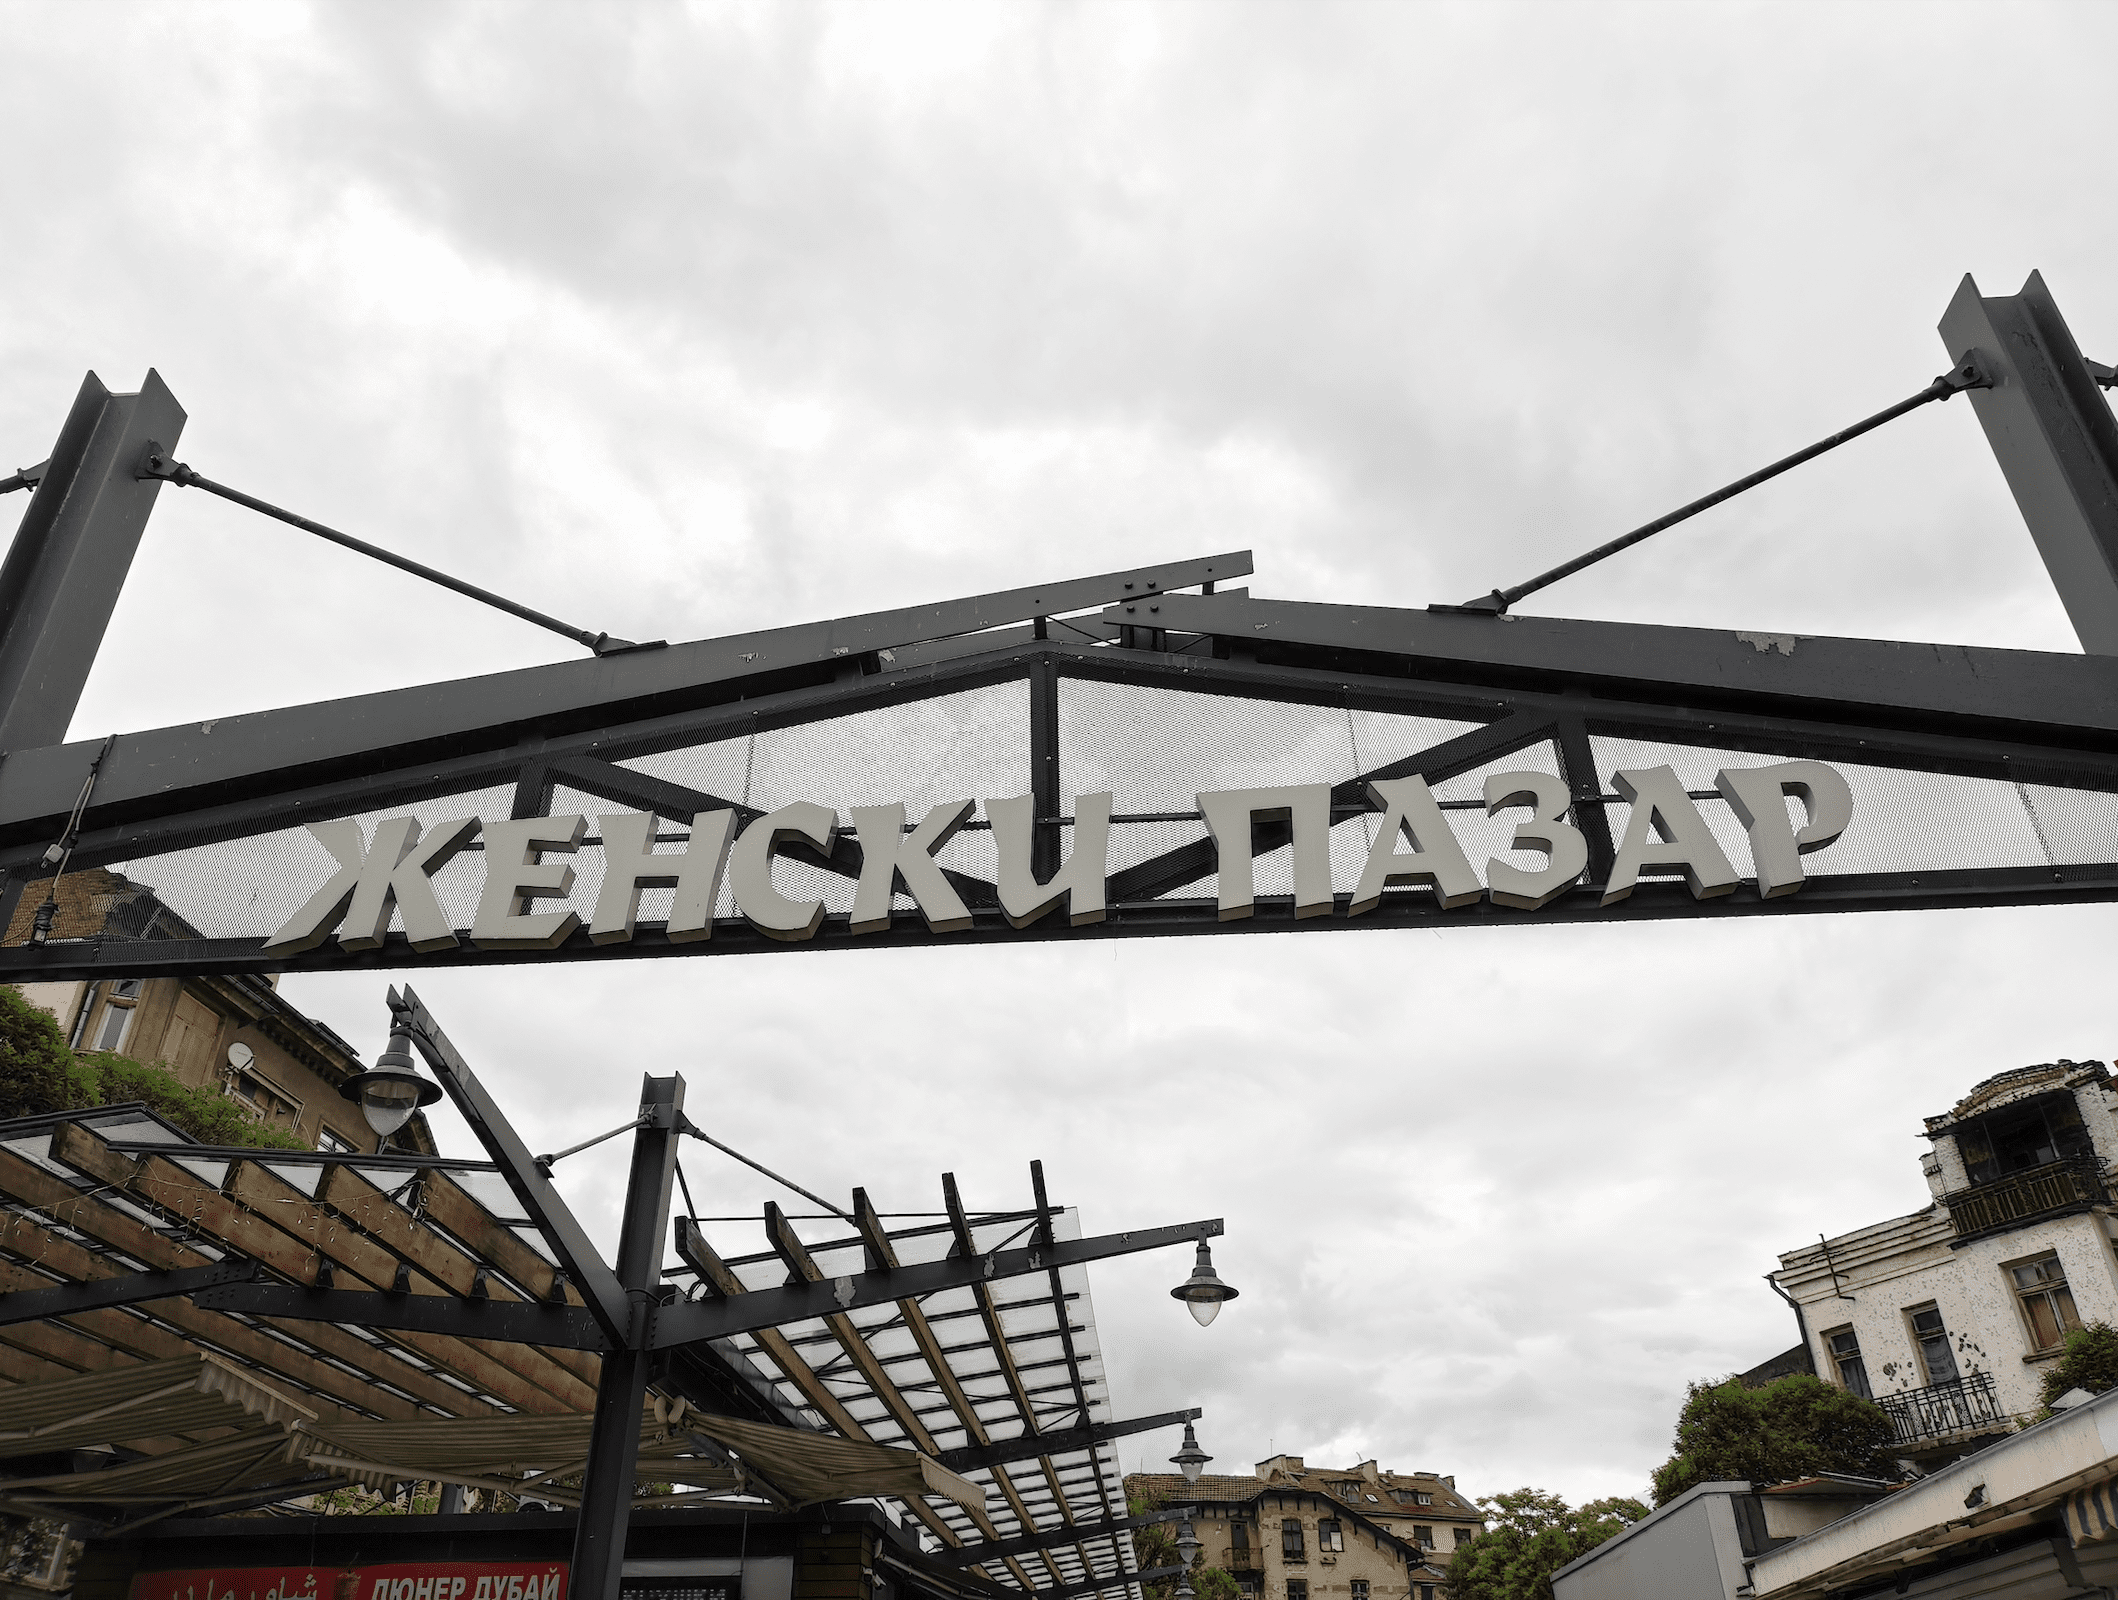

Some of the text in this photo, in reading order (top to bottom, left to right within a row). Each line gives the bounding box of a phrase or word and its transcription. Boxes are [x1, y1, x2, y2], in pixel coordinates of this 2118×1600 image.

[262, 760, 1853, 951] ЖЕНСКИ ПАЗАР
[471, 1567, 561, 1600] ДУБАЙ
